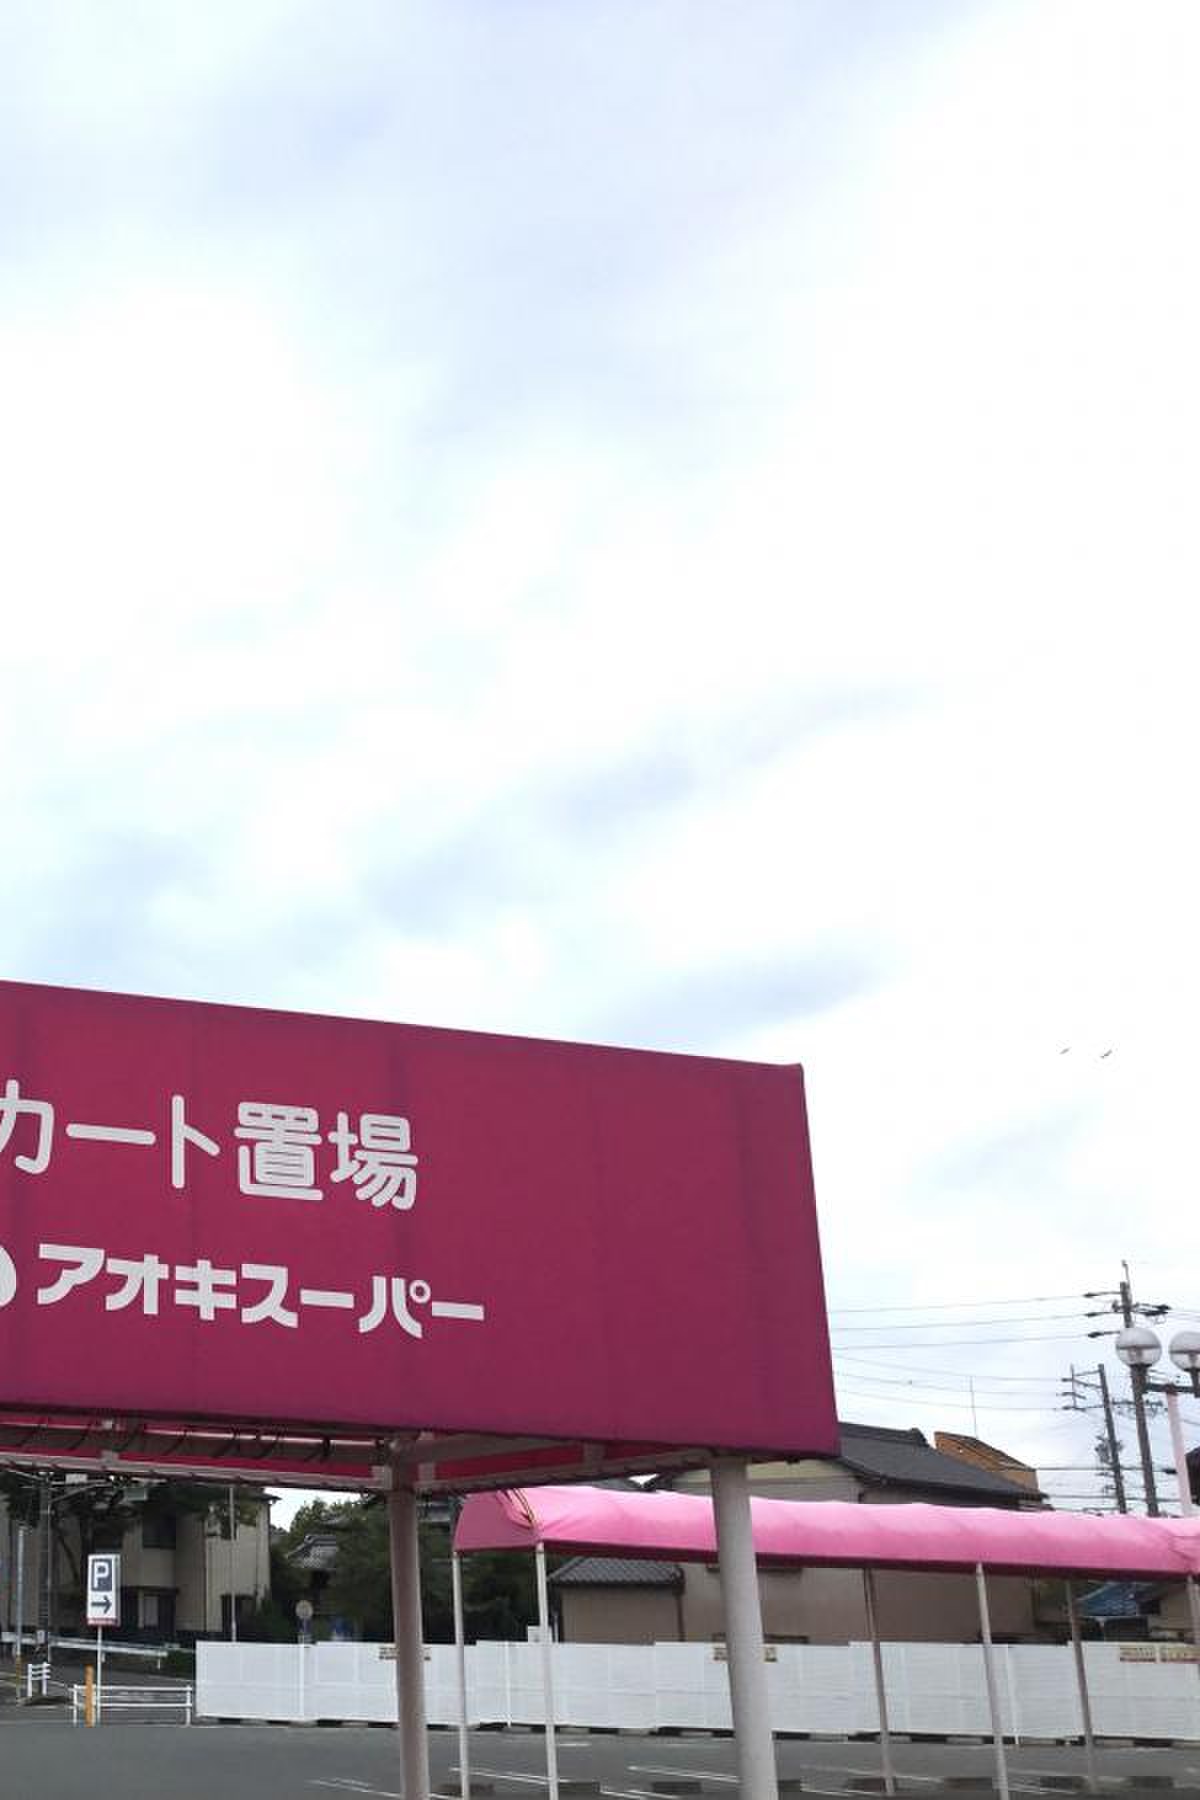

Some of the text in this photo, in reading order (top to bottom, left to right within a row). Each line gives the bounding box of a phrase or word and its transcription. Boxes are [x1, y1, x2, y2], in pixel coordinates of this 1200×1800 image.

[37, 1243, 485, 1339] アオキスーパー
[93, 1561, 110, 1589] P
